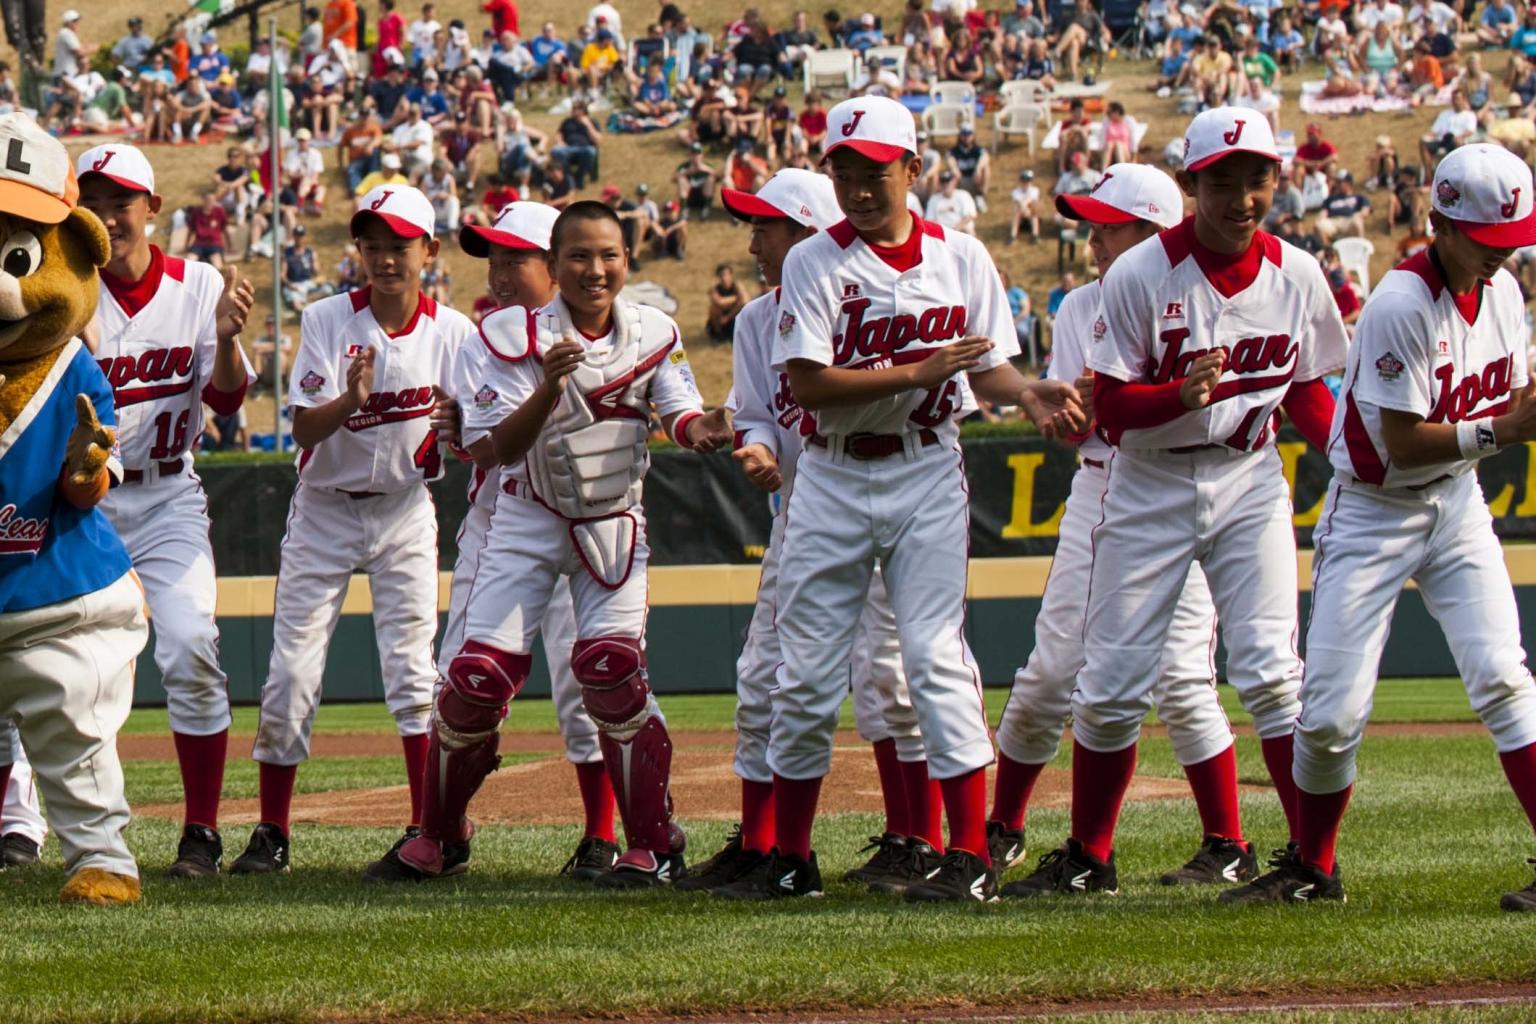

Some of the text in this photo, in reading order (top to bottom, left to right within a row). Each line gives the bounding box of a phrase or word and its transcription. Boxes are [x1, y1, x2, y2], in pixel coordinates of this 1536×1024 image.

[841, 109, 866, 136] J
[1224, 119, 1247, 146] J
[92, 150, 116, 172] J
[370, 189, 395, 212] J
[1501, 186, 1521, 218] J
[832, 296, 968, 366] Japan
[360, 385, 436, 415] apan
[413, 429, 441, 479] 4
